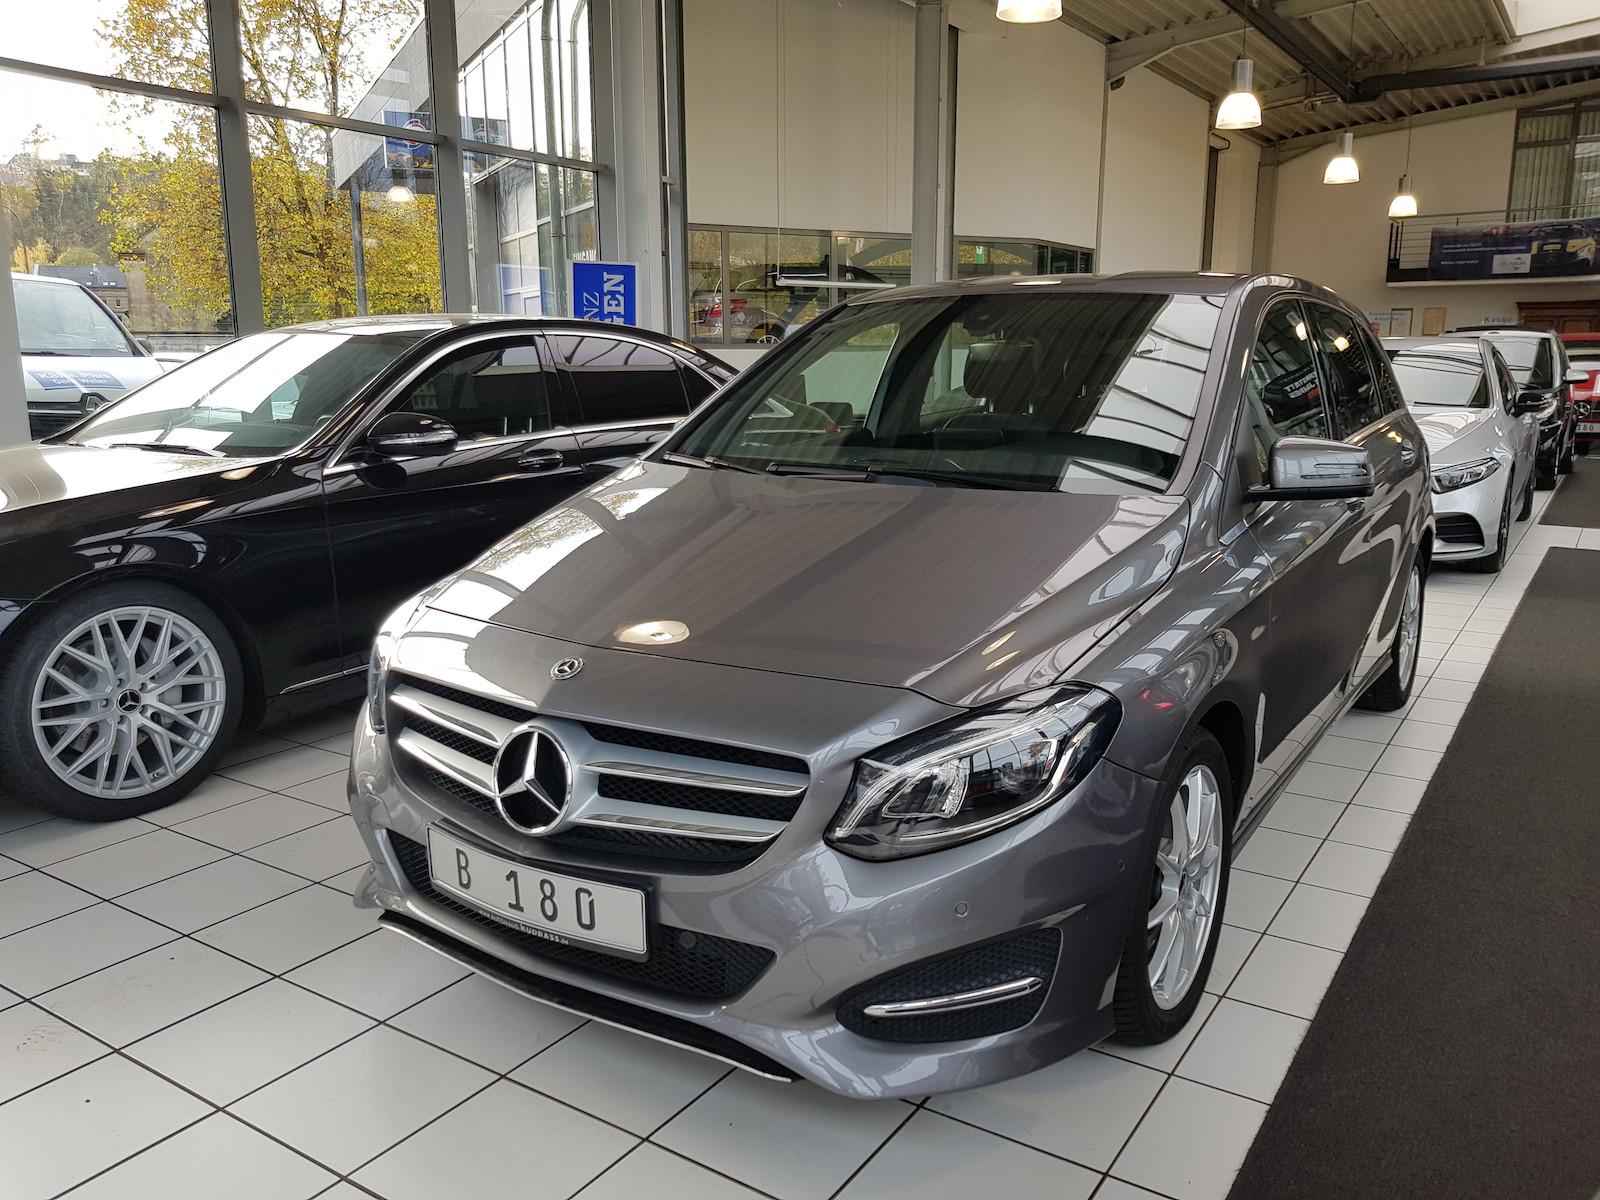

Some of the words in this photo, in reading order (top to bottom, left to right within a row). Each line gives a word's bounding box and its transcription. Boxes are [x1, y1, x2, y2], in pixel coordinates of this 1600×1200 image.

[583, 291, 600, 321] NZ
[455, 847, 472, 890] B
[505, 869, 597, 931] 180
